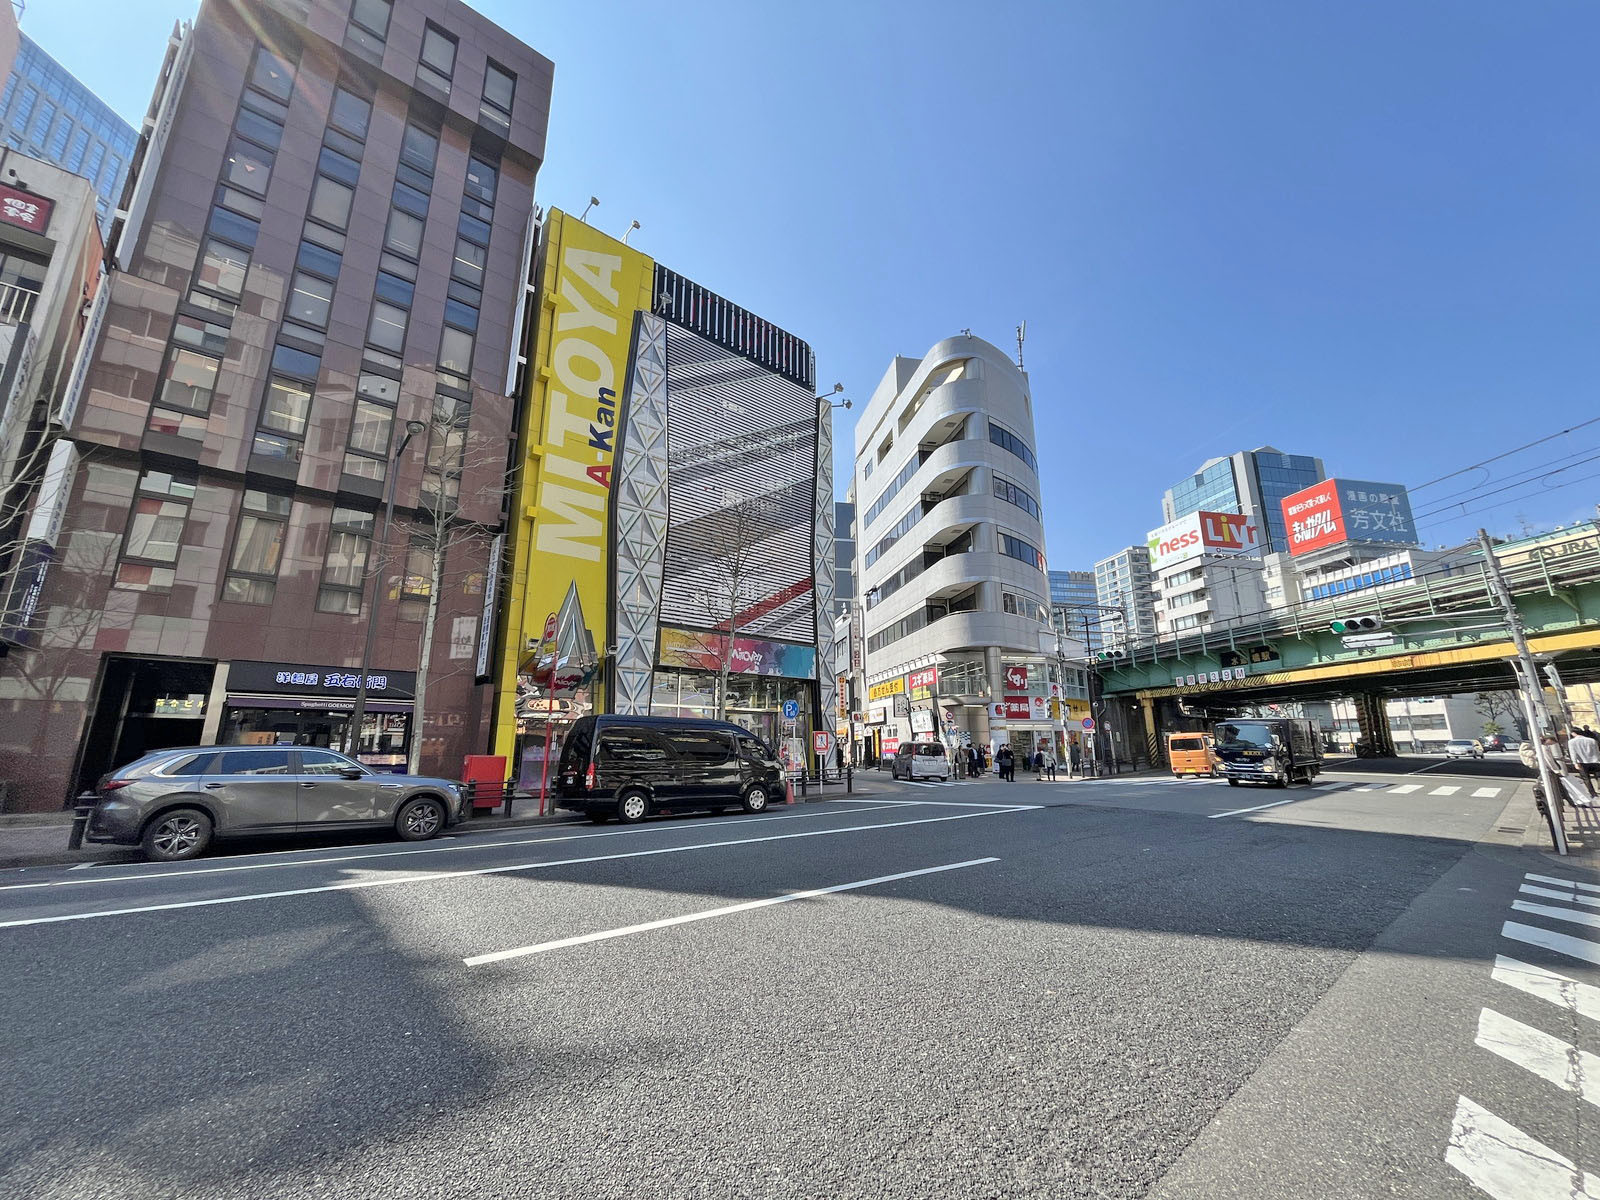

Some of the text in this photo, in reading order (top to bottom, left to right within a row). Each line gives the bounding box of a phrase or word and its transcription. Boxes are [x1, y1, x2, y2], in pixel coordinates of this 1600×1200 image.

[536, 246, 622, 562] MITOYA
[586, 386, 617, 489] A-Kan
[1350, 508, 1408, 532] 芳文社
[1558, 540, 1593, 557] JRA
[328, 702, 355, 710] GOEMON
